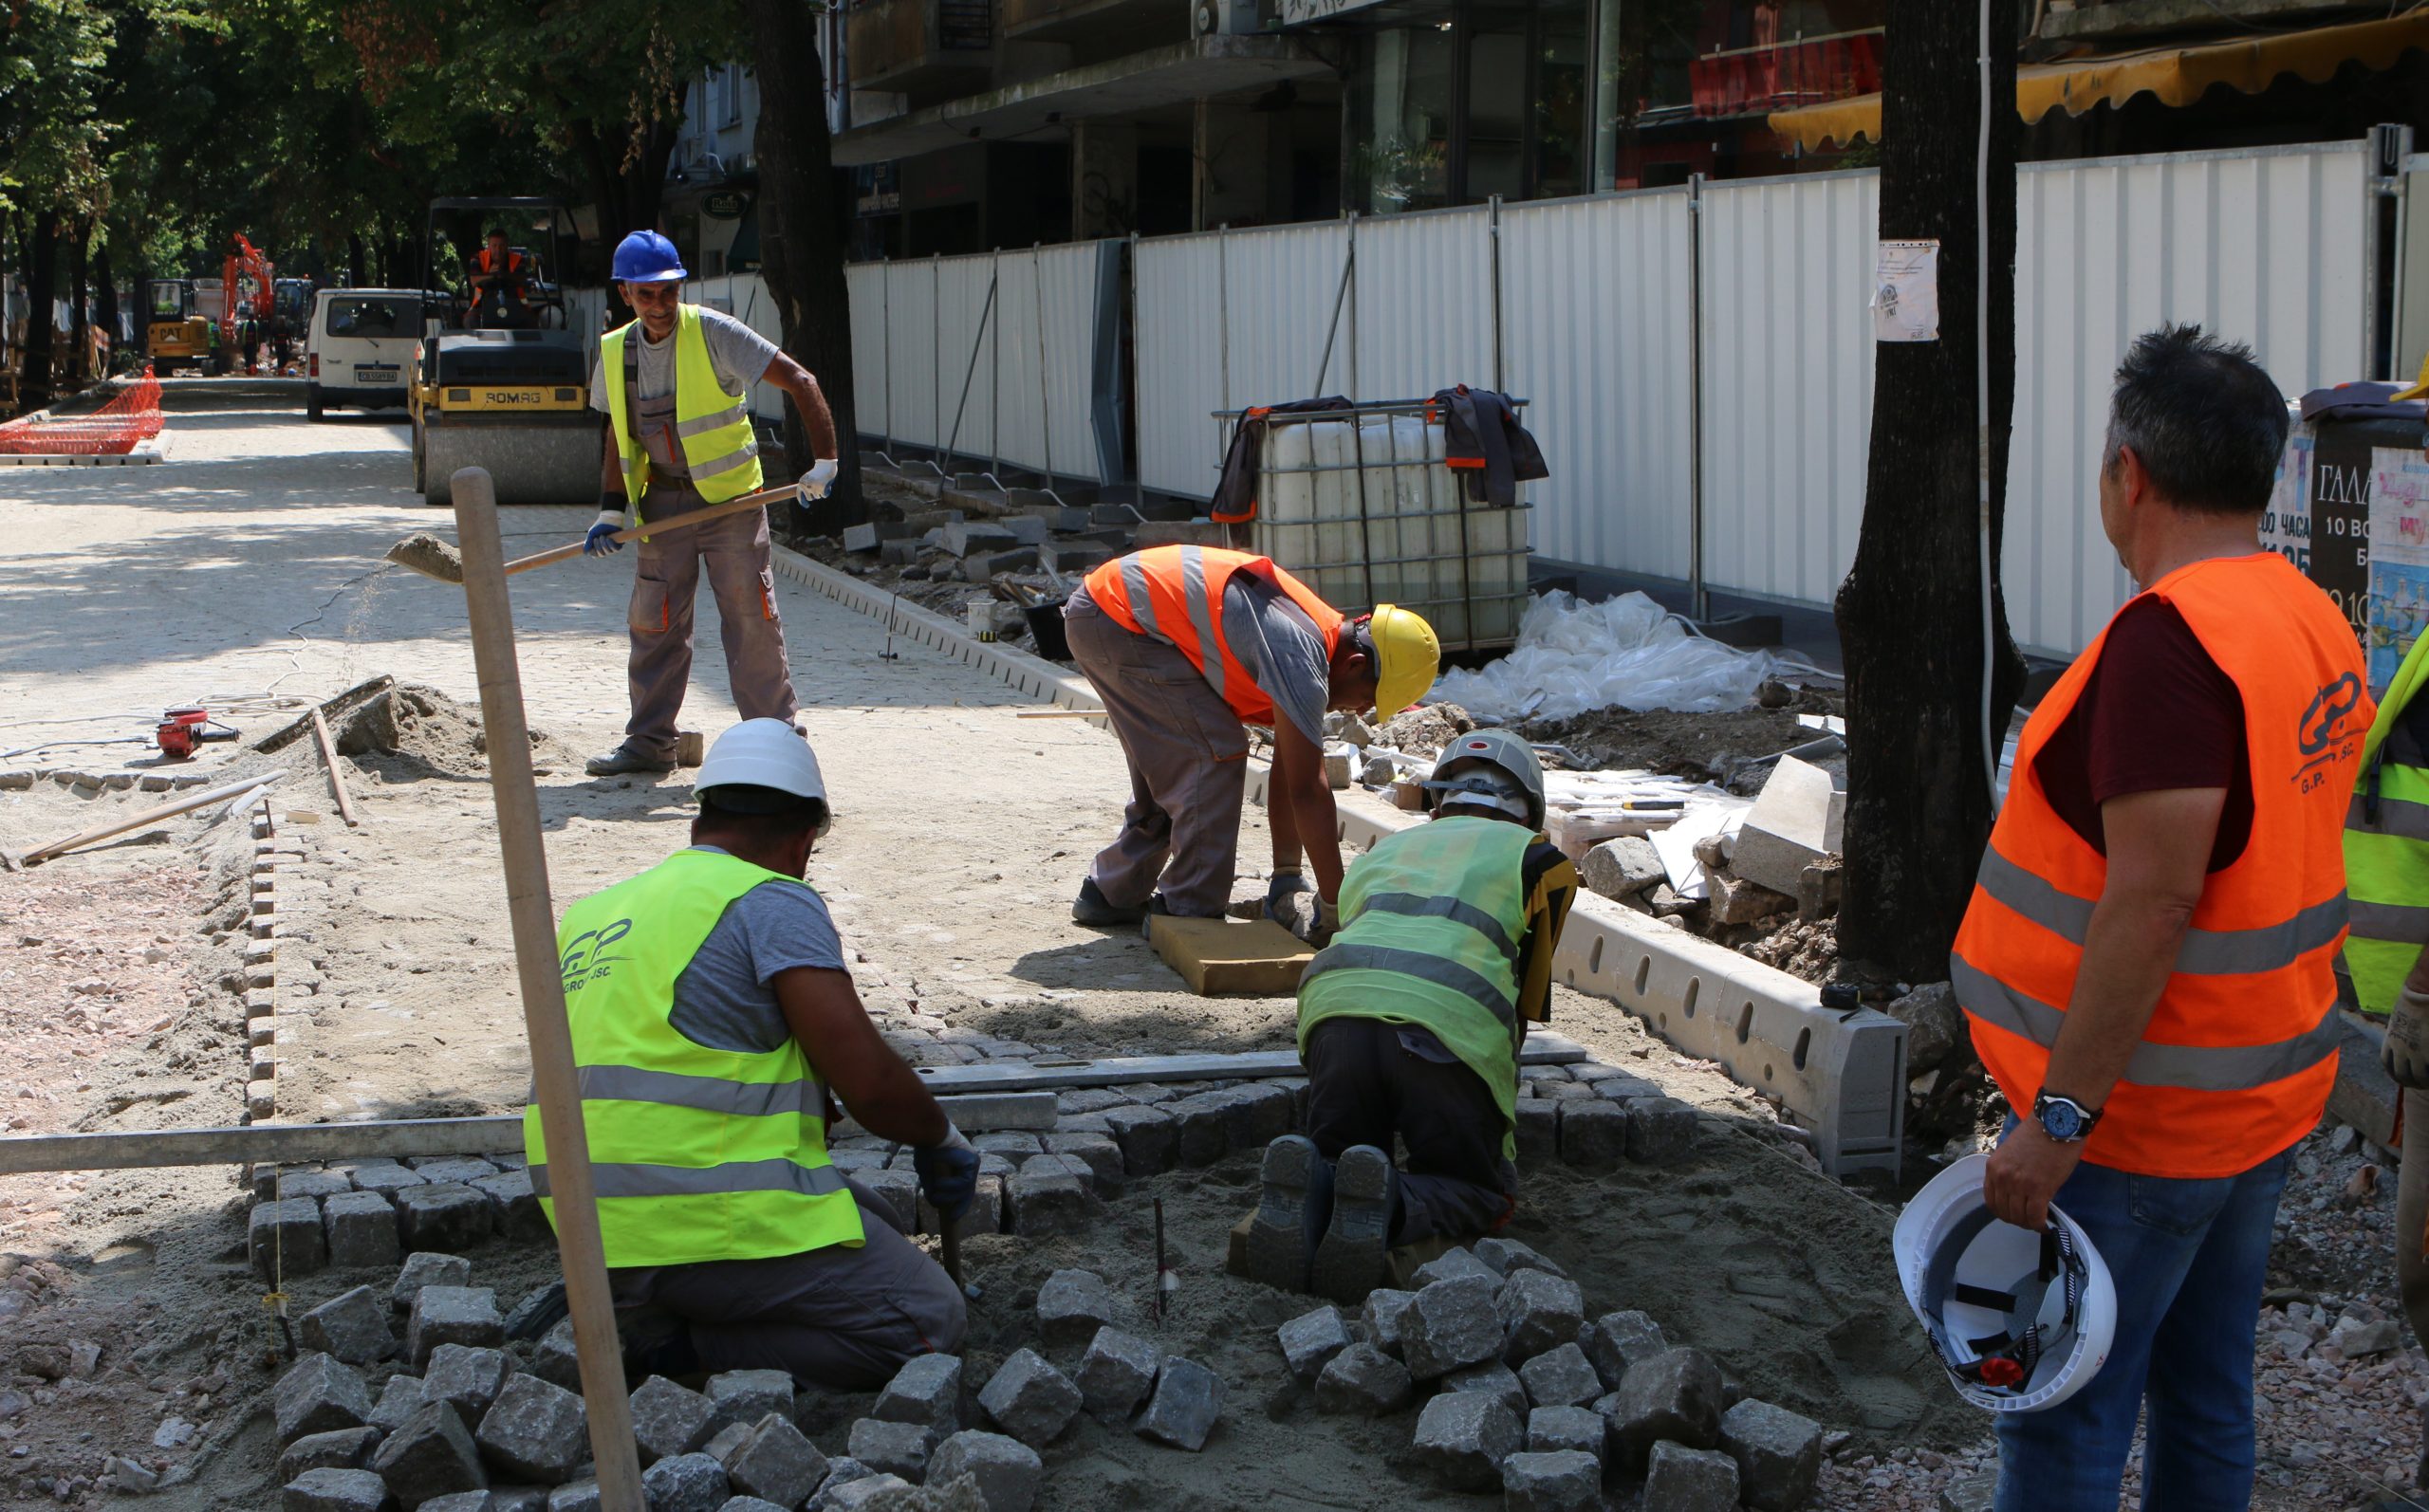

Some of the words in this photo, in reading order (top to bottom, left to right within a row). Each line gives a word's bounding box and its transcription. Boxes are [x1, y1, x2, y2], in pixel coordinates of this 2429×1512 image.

[159, 327, 182, 341] CAT
[2281, 513, 2310, 539] ЧАСА
[2327, 516, 2345, 535] 10
